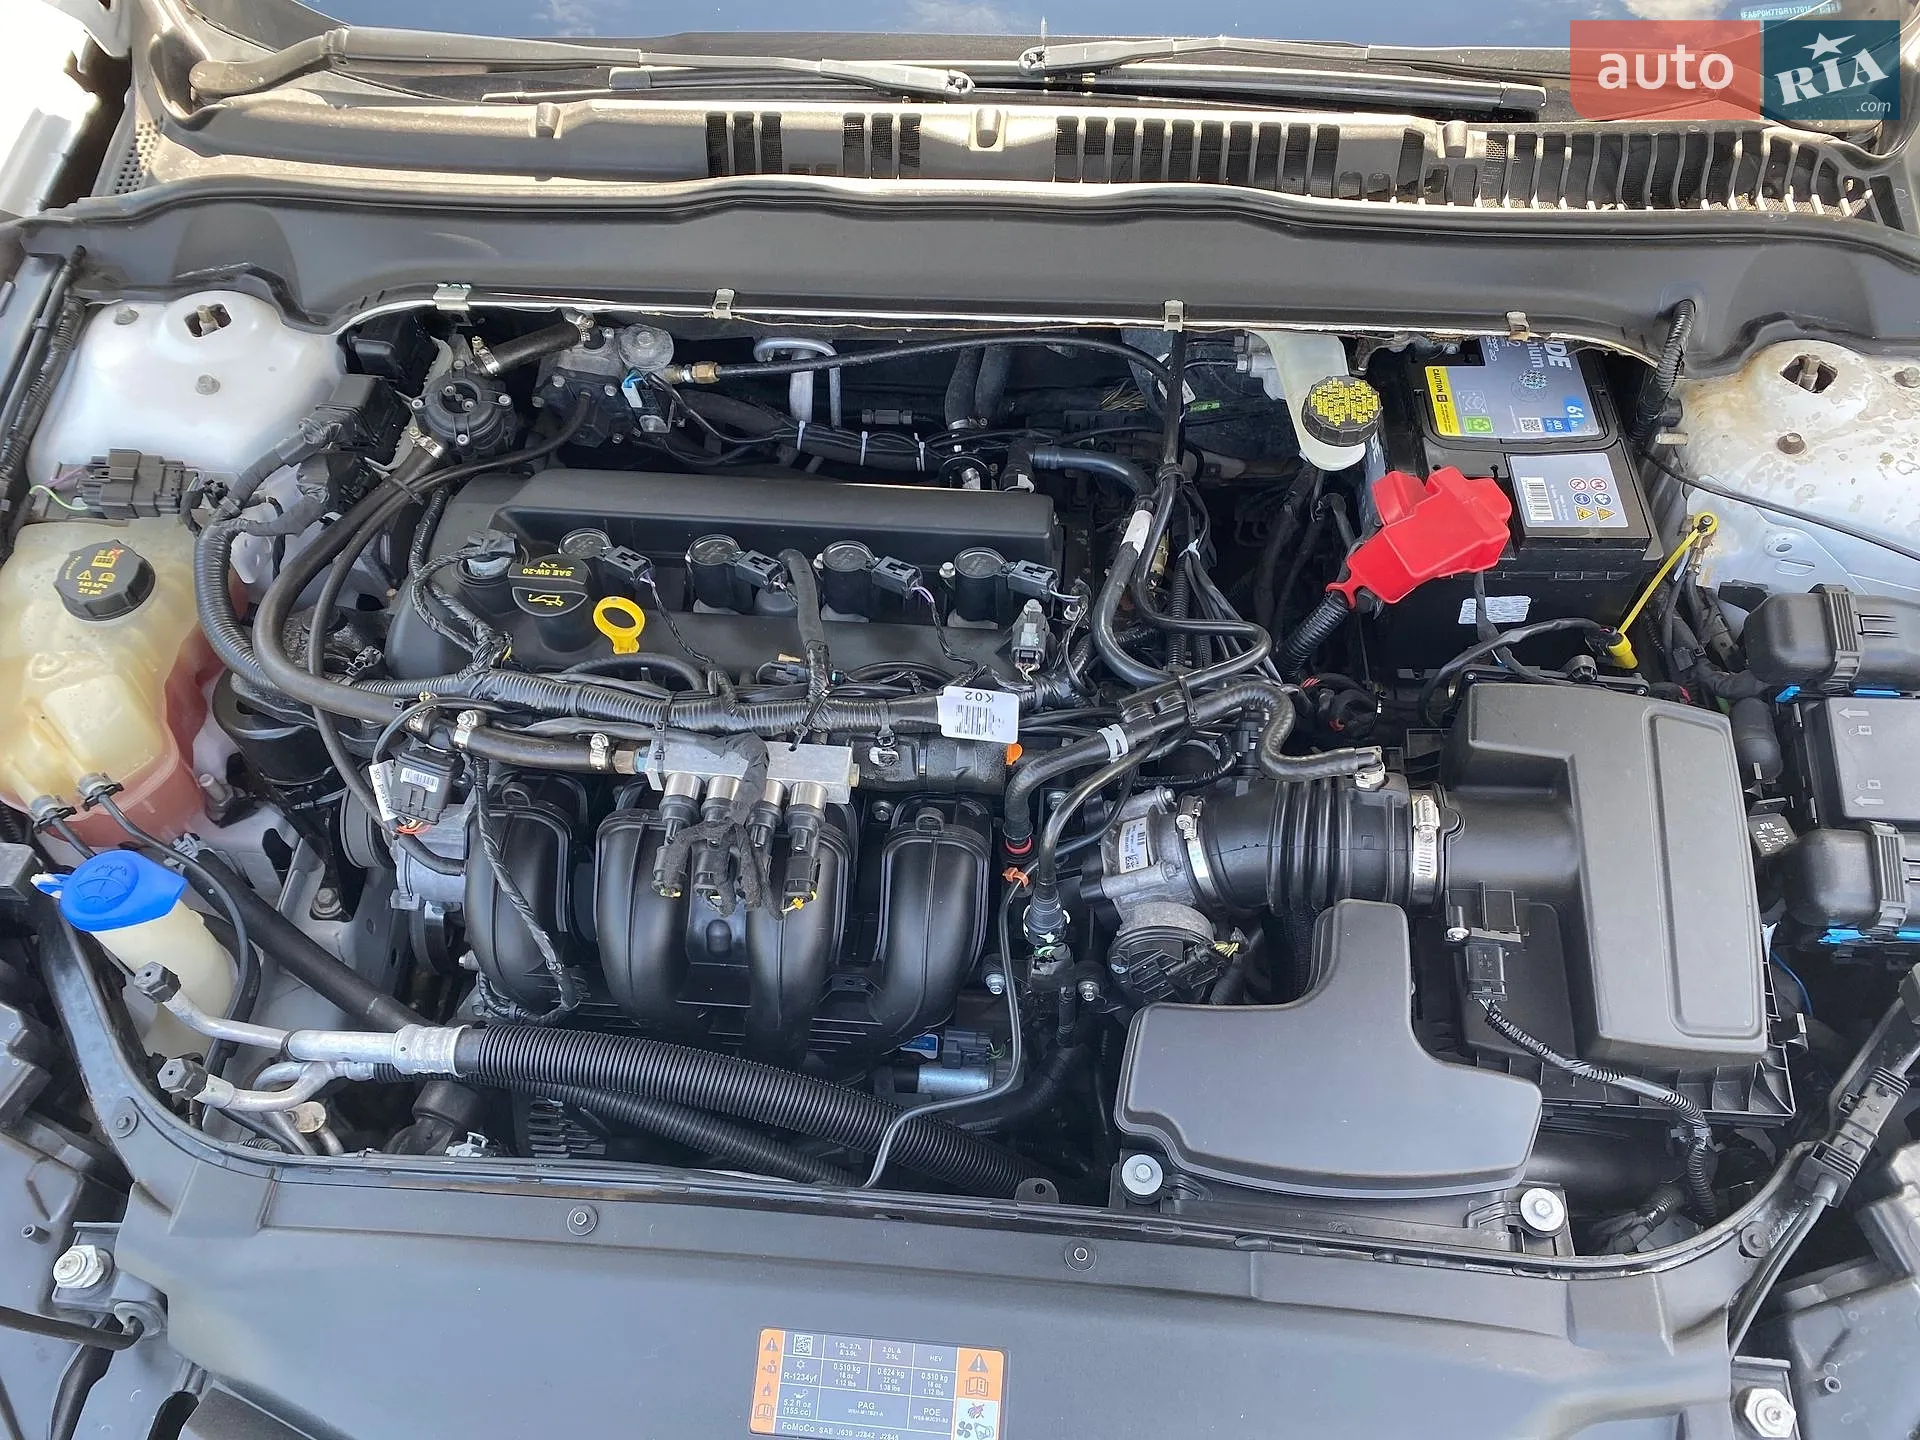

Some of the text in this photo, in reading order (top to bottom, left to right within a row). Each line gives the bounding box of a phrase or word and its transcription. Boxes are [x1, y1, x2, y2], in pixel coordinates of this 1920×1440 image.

[1433, 368, 1444, 393] CAUTION
[1567, 405, 1585, 418] 61
[522, 568, 573, 577] SAE 5W-20
[964, 690, 994, 703] K02
[833, 1362, 862, 1375] 0.510 kg
[896, 1369, 906, 1380] kg
[783, 1371, 819, 1384] R-1234yf
[921, 1372, 949, 1384] 0.510 kg
[783, 1398, 796, 1407] 5.2
[802, 1401, 812, 1409] oz
[857, 1401, 876, 1411] PAG
[922, 1407, 942, 1417] POE
[781, 1421, 816, 1433] FoMoCo
[818, 1426, 834, 1435] SAE
